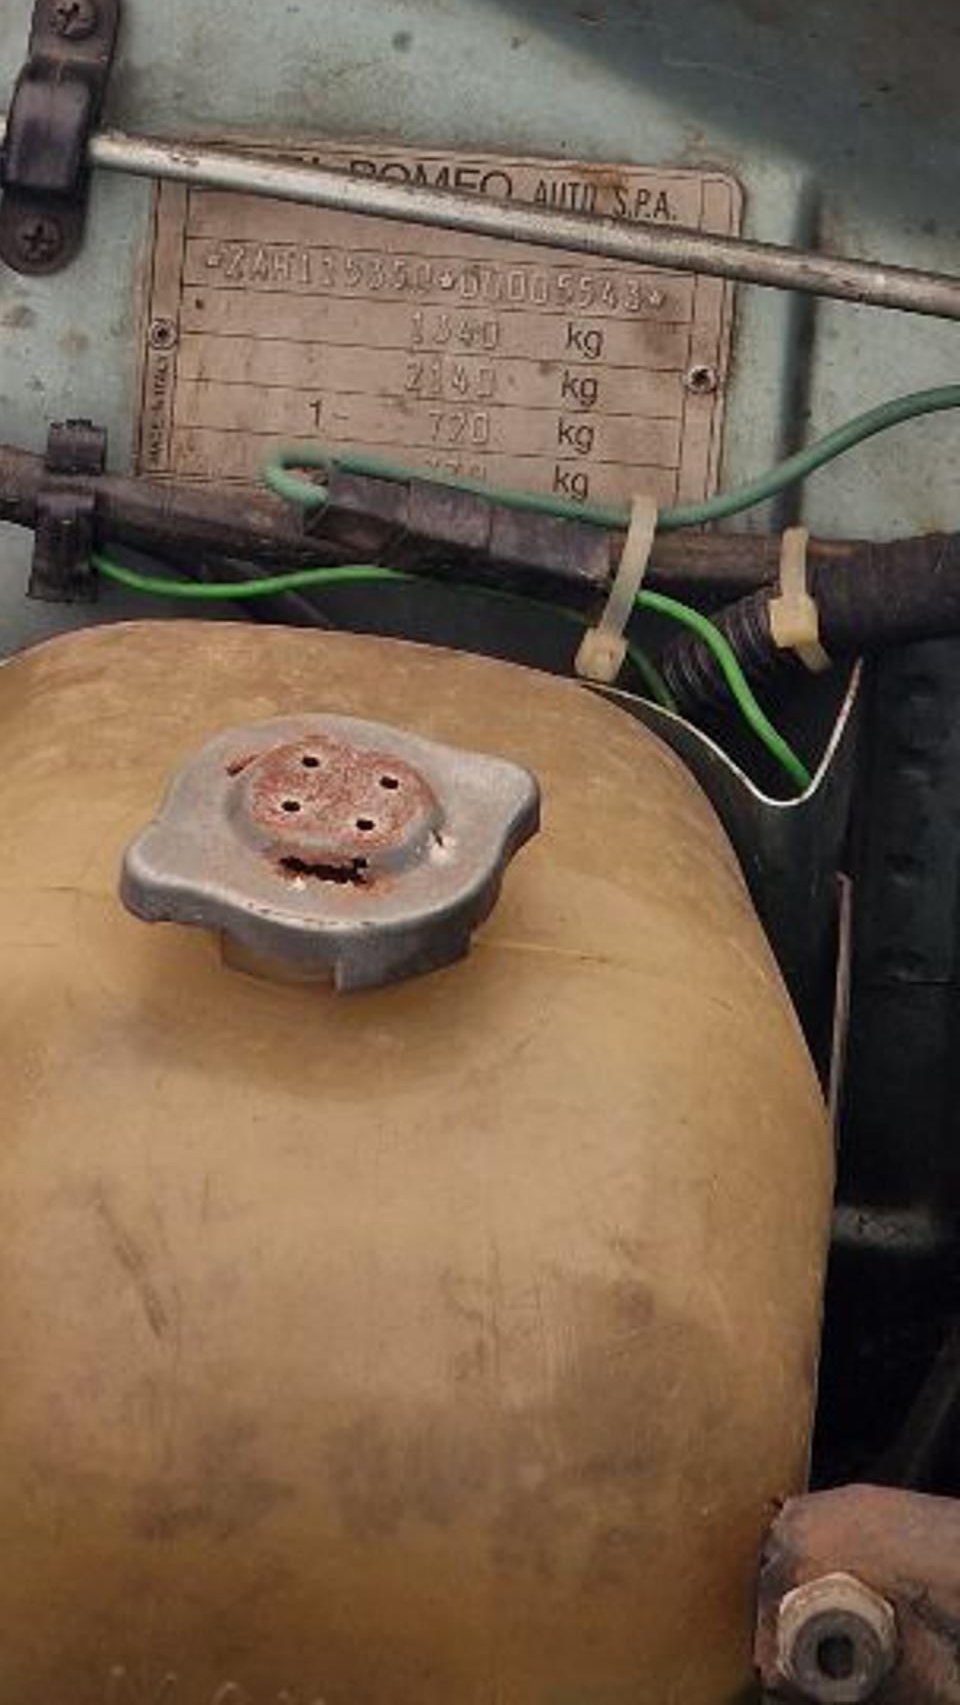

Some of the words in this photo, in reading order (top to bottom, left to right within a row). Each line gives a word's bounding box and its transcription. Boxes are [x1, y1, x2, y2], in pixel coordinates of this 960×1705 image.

[566, 321, 604, 359] kg
[560, 369, 599, 407] kg
[557, 417, 595, 455] kg
[552, 464, 590, 503] kg
